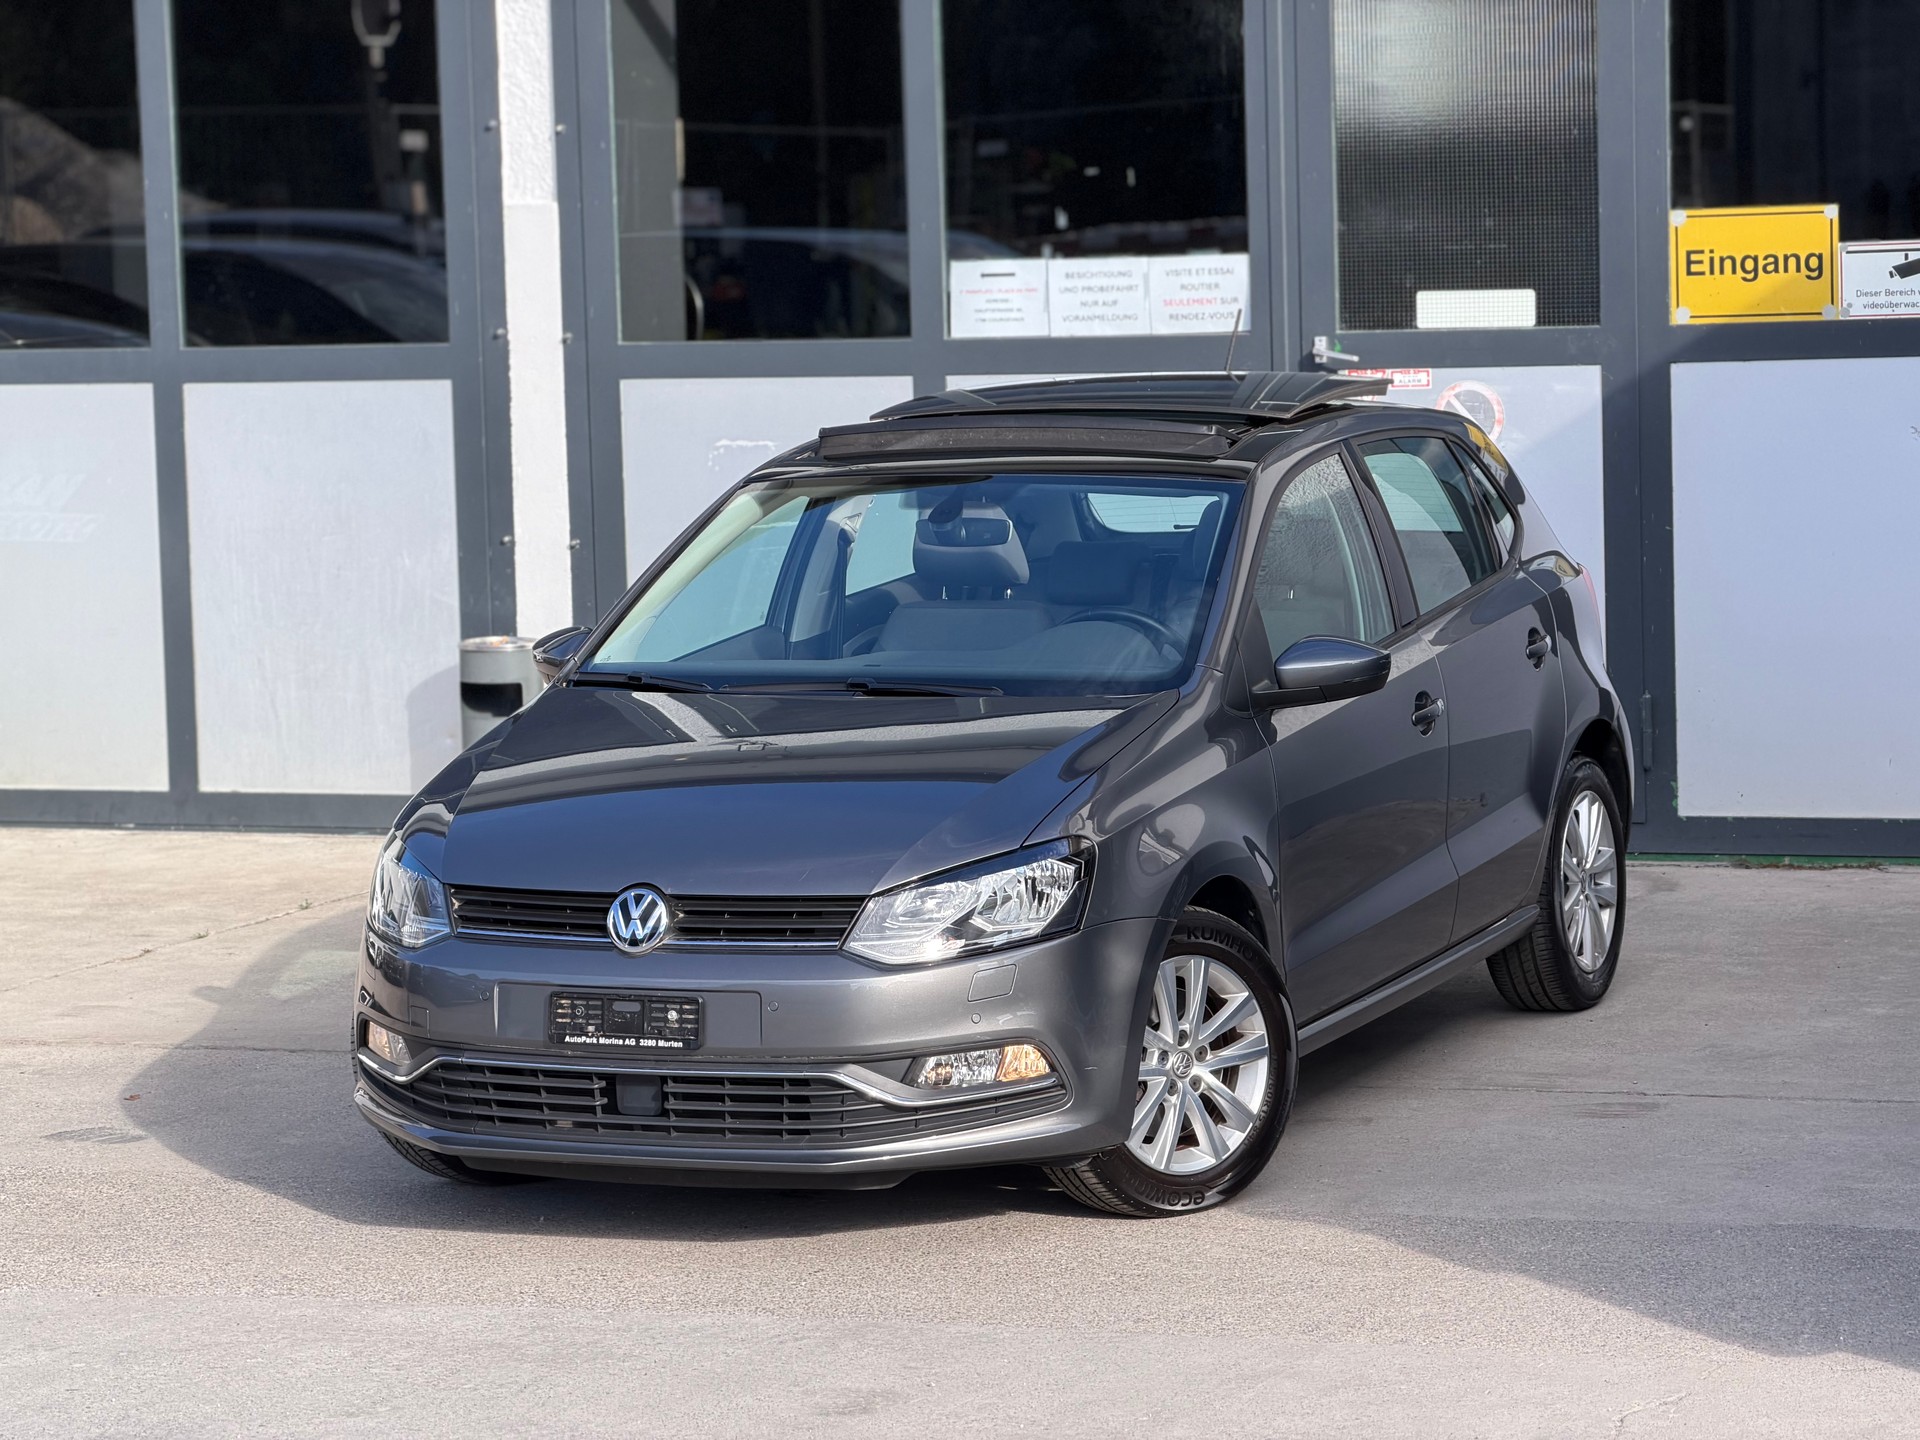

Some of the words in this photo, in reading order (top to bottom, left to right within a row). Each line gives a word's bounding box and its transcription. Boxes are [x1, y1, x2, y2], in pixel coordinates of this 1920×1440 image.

[1685, 248, 1824, 282] Eingang
[1064, 270, 1133, 279] BESICHTIGUNG
[1164, 267, 1192, 277] VISITE
[1195, 267, 1206, 276] ET
[1208, 266, 1234, 276] ESSAI
[1059, 285, 1079, 294] UND
[1081, 283, 1139, 293] PROBEFAHRT
[1180, 282, 1220, 291] ROUTIER
[1855, 289, 1883, 298] Dieser
[1884, 287, 1916, 297] Bereich
[1080, 299, 1099, 307] NUR
[1102, 299, 1118, 307] AUF
[1163, 297, 1217, 307] SEULEMENT
[1220, 296, 1239, 305] SUR
[1061, 312, 1138, 322] VORANMELDUNG
[1168, 311, 1235, 320] RENDEZ-VOUS
[607, 889, 668, 953] VW
[1186, 926, 1253, 961] KUMHO
[564, 1035, 598, 1044] AutoPark
[598, 1037, 623, 1045] Morina
[624, 1038, 636, 1046] AG
[639, 1038, 657, 1047] 3280
[657, 1039, 683, 1048] Murten
